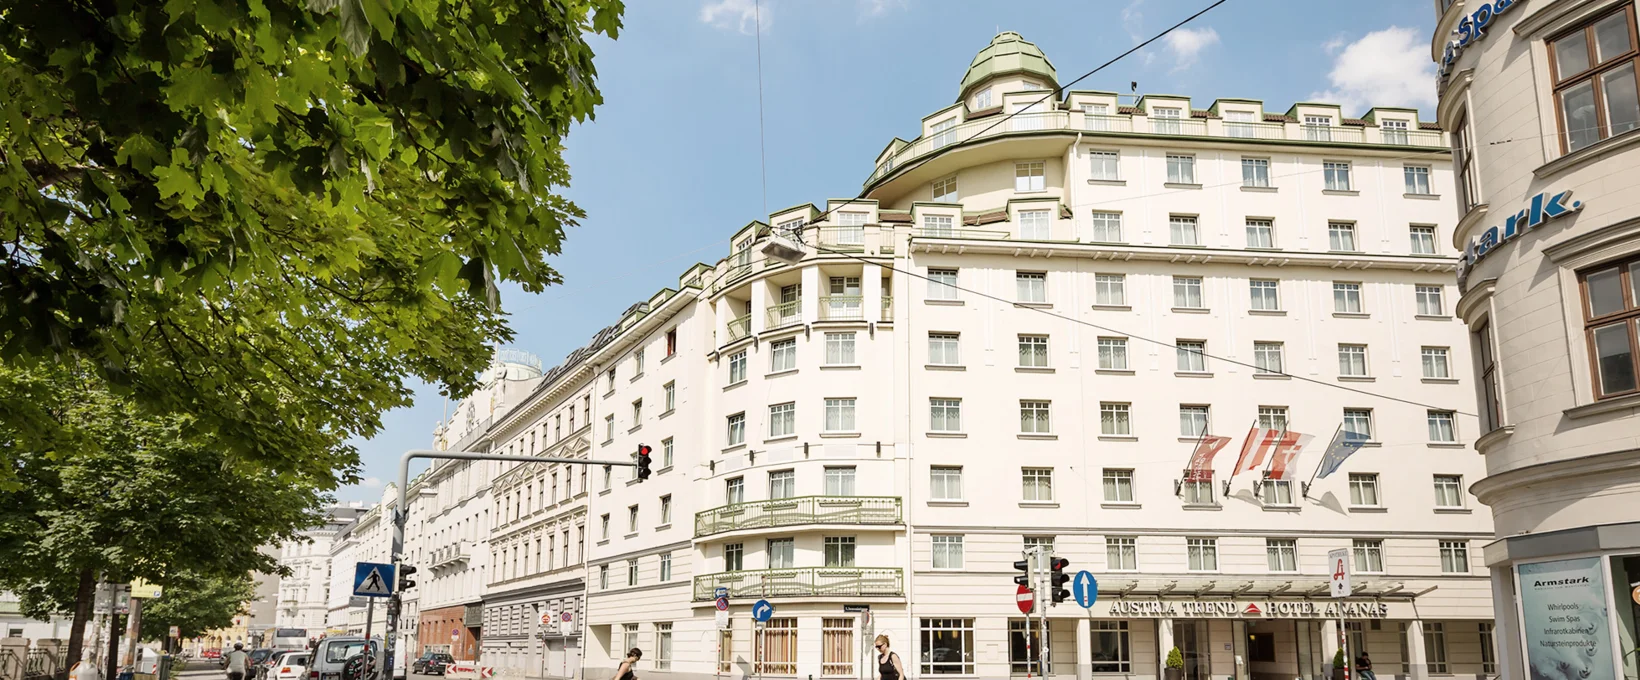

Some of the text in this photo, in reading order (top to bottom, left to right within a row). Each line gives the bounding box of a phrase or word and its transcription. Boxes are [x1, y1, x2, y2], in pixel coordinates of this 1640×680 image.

[1534, 576, 1589, 586] Armstark
[1109, 601, 1177, 616] AUSTRIA
[1182, 601, 1239, 616] TREND
[1265, 602, 1320, 617] HOTEL
[1547, 602, 1580, 611] Whirlpools
[1548, 615, 1581, 623] Swim Spas
[1543, 626, 1590, 635] Infrarotkabinen
[1539, 639, 1597, 649] Natursteinprodukte
